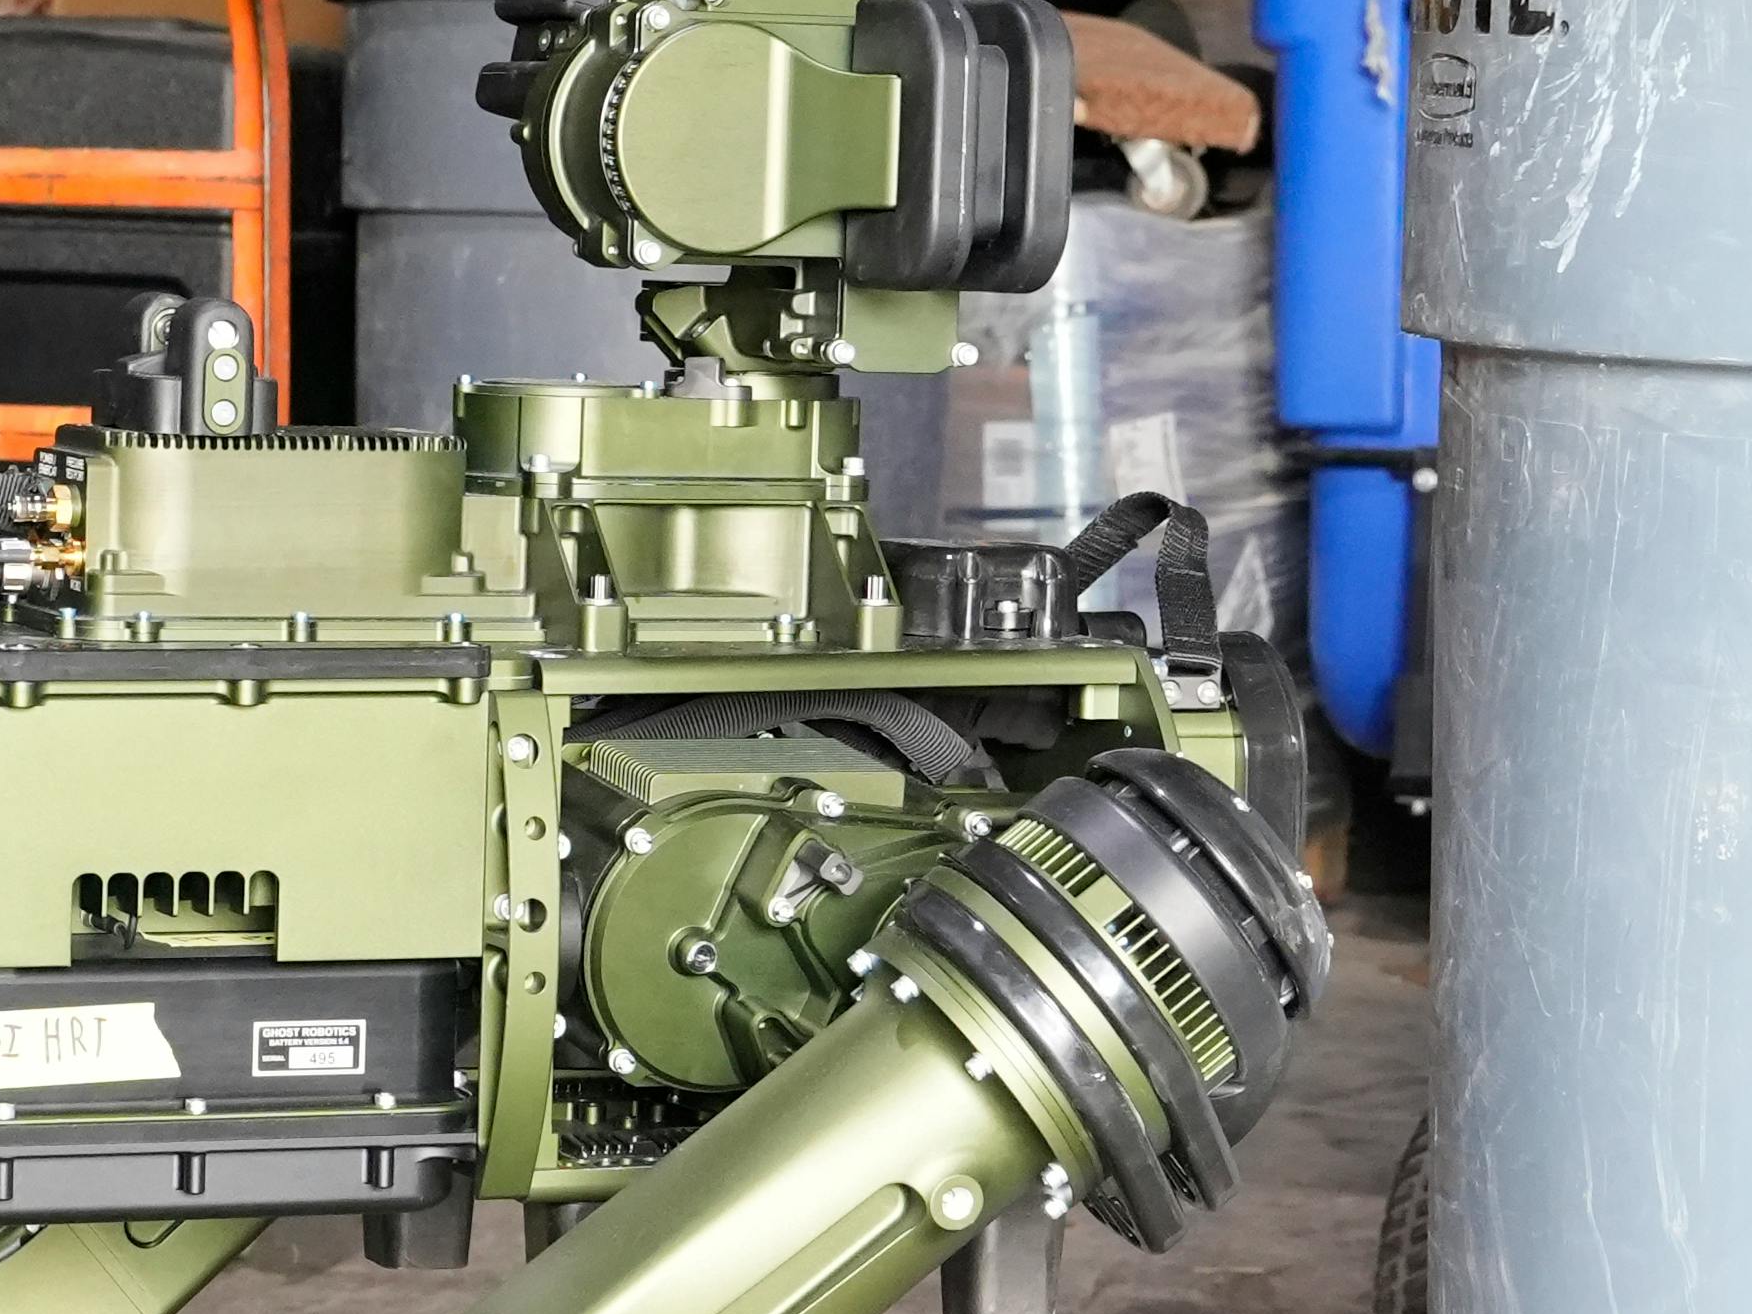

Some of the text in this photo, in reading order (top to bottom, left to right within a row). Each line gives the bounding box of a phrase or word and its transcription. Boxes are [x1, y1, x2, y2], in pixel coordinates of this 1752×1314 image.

[262, 1026, 356, 1038] GHOST ROBOTICS
[44, 1016, 108, 1063] HRT
[269, 1038, 303, 1046] BATTERY
[309, 1052, 335, 1064] 495
